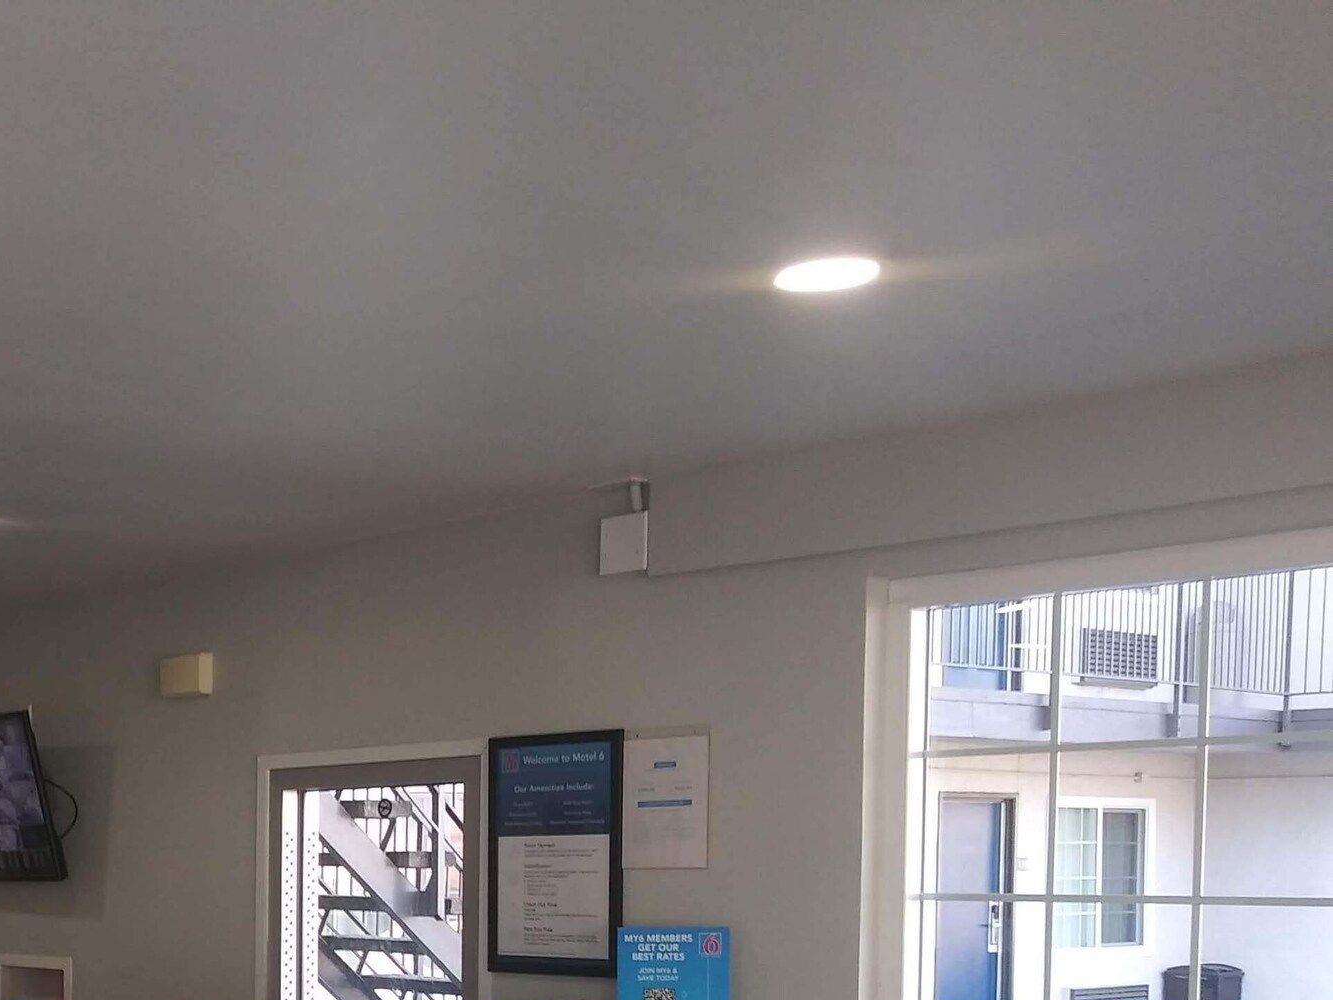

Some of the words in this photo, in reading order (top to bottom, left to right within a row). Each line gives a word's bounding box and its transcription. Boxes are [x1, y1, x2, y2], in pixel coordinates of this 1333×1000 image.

[523, 753, 559, 765] Welcome
[561, 754, 570, 763] to
[573, 751, 597, 762] Motel
[599, 751, 605, 761] 6
[624, 934, 645, 943] MY6
[646, 934, 693, 943] MEMBERS
[637, 943, 656, 952] GET
[658, 943, 679, 952] OUR
[702, 934, 720, 955] 6
[632, 953, 655, 961] BEST
[656, 952, 685, 961] RATES
